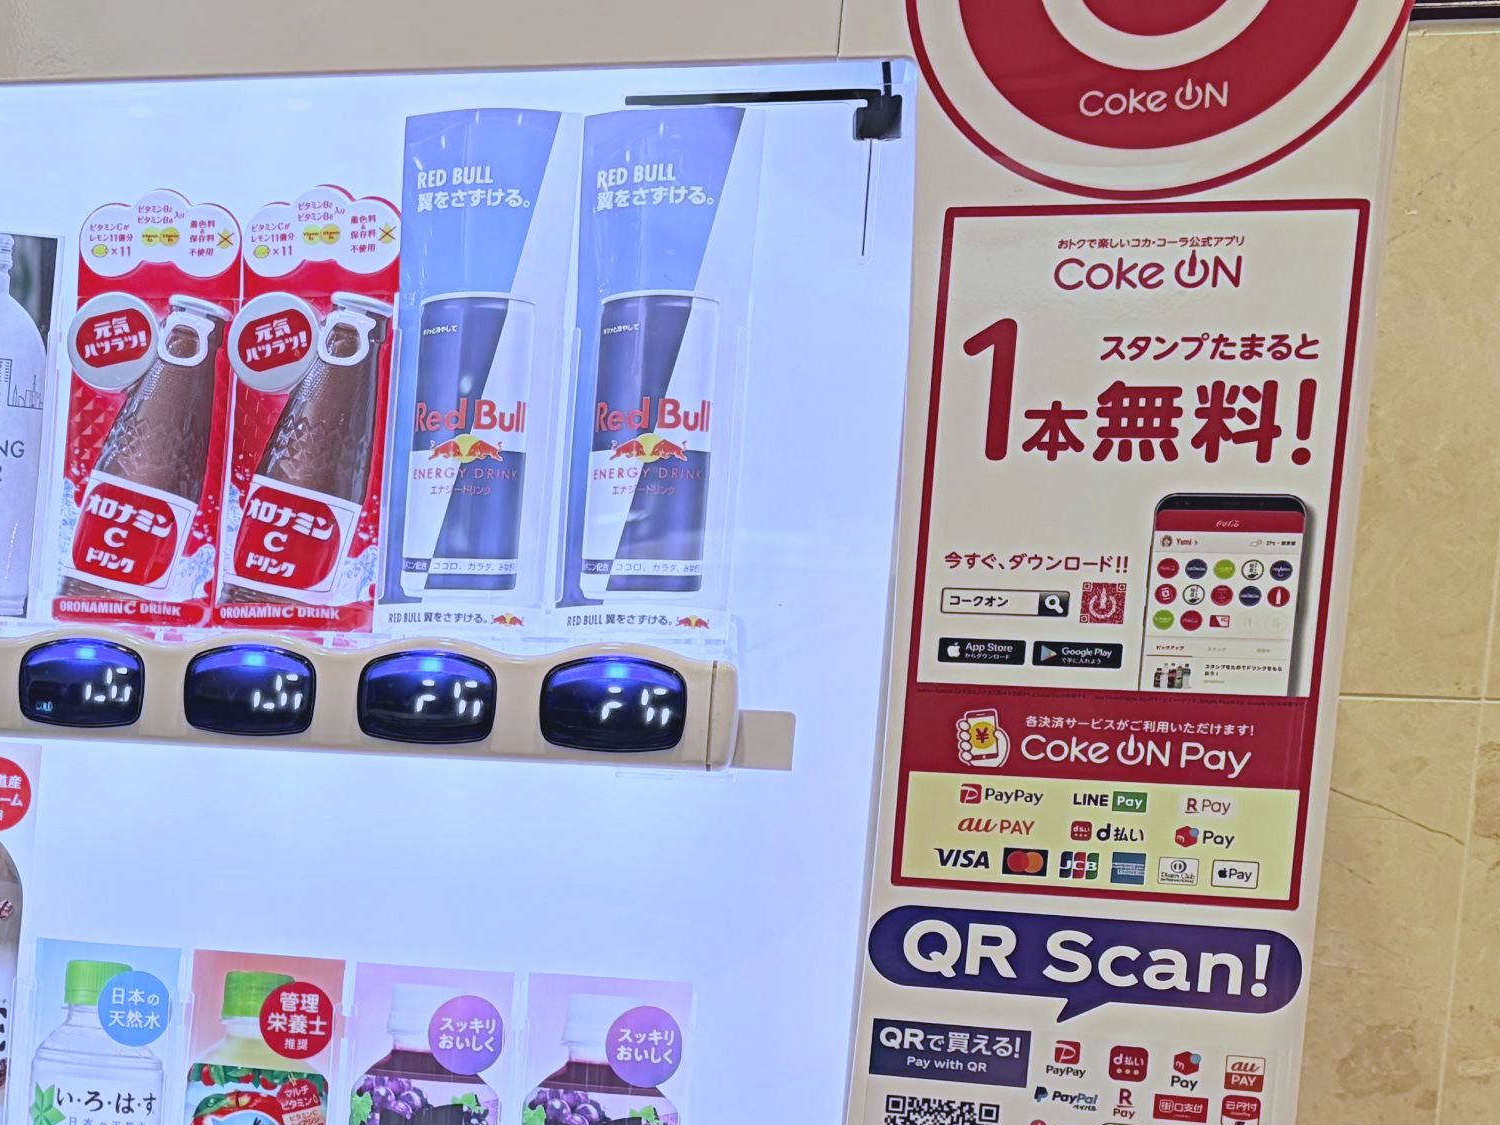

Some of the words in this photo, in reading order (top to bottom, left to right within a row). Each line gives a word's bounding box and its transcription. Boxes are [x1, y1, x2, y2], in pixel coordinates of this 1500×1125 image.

[1079, 85, 1166, 118] Coke
[1174, 78, 1229, 110] ON
[417, 168, 448, 188] RED
[452, 165, 494, 186] BULL
[417, 188, 531, 212] 翼をさずける。
[1058, 234, 1245, 251] おトクで楽しいコカ・コーラ公式アプリ
[1054, 256, 1166, 290] Coke
[1174, 250, 1243, 289] ON
[94, 317, 129, 341] 元気
[84, 332, 147, 359] ハツラツ!
[1100, 332, 1320, 362] スタンプたまると
[595, 397, 649, 431] Red
[657, 397, 710, 432] Bull
[87, 492, 175, 539] オロナミン
[104, 527, 128, 550] C
[85, 550, 135, 575] ドリンク
[944, 551, 1129, 574] 今すぐ、ダウンロード!!
[965, 643, 985, 654] App
[987, 643, 1013, 654] Store
[1062, 646, 1091, 660] Google
[1094, 647, 1113, 661] Play
[1025, 715, 1254, 736] 各決済サービスがご利用いただけます!
[1021, 734, 1109, 764] Coke
[1116, 734, 1170, 768] ON
[1180, 744, 1251, 779] Pay
[985, 788, 1043, 806] PayPay
[934, 847, 990, 869] VISA
[902, 919, 1017, 979] QR
[1042, 929, 1271, 998] Scan!
[111, 987, 161, 1007] 日本の
[278, 990, 320, 1014] 管理
[108, 1008, 162, 1029] 天然水
[268, 1013, 328, 1037] 栄養士
[440, 1017, 496, 1036] スッキリ
[284, 1038, 308, 1051] 推奨
[438, 1034, 496, 1054] おいしく
[879, 1026, 1020, 1059] QRで買える!
[906, 1056, 929, 1070] Pay
[933, 1058, 961, 1071] with
[964, 1060, 988, 1074] QR
